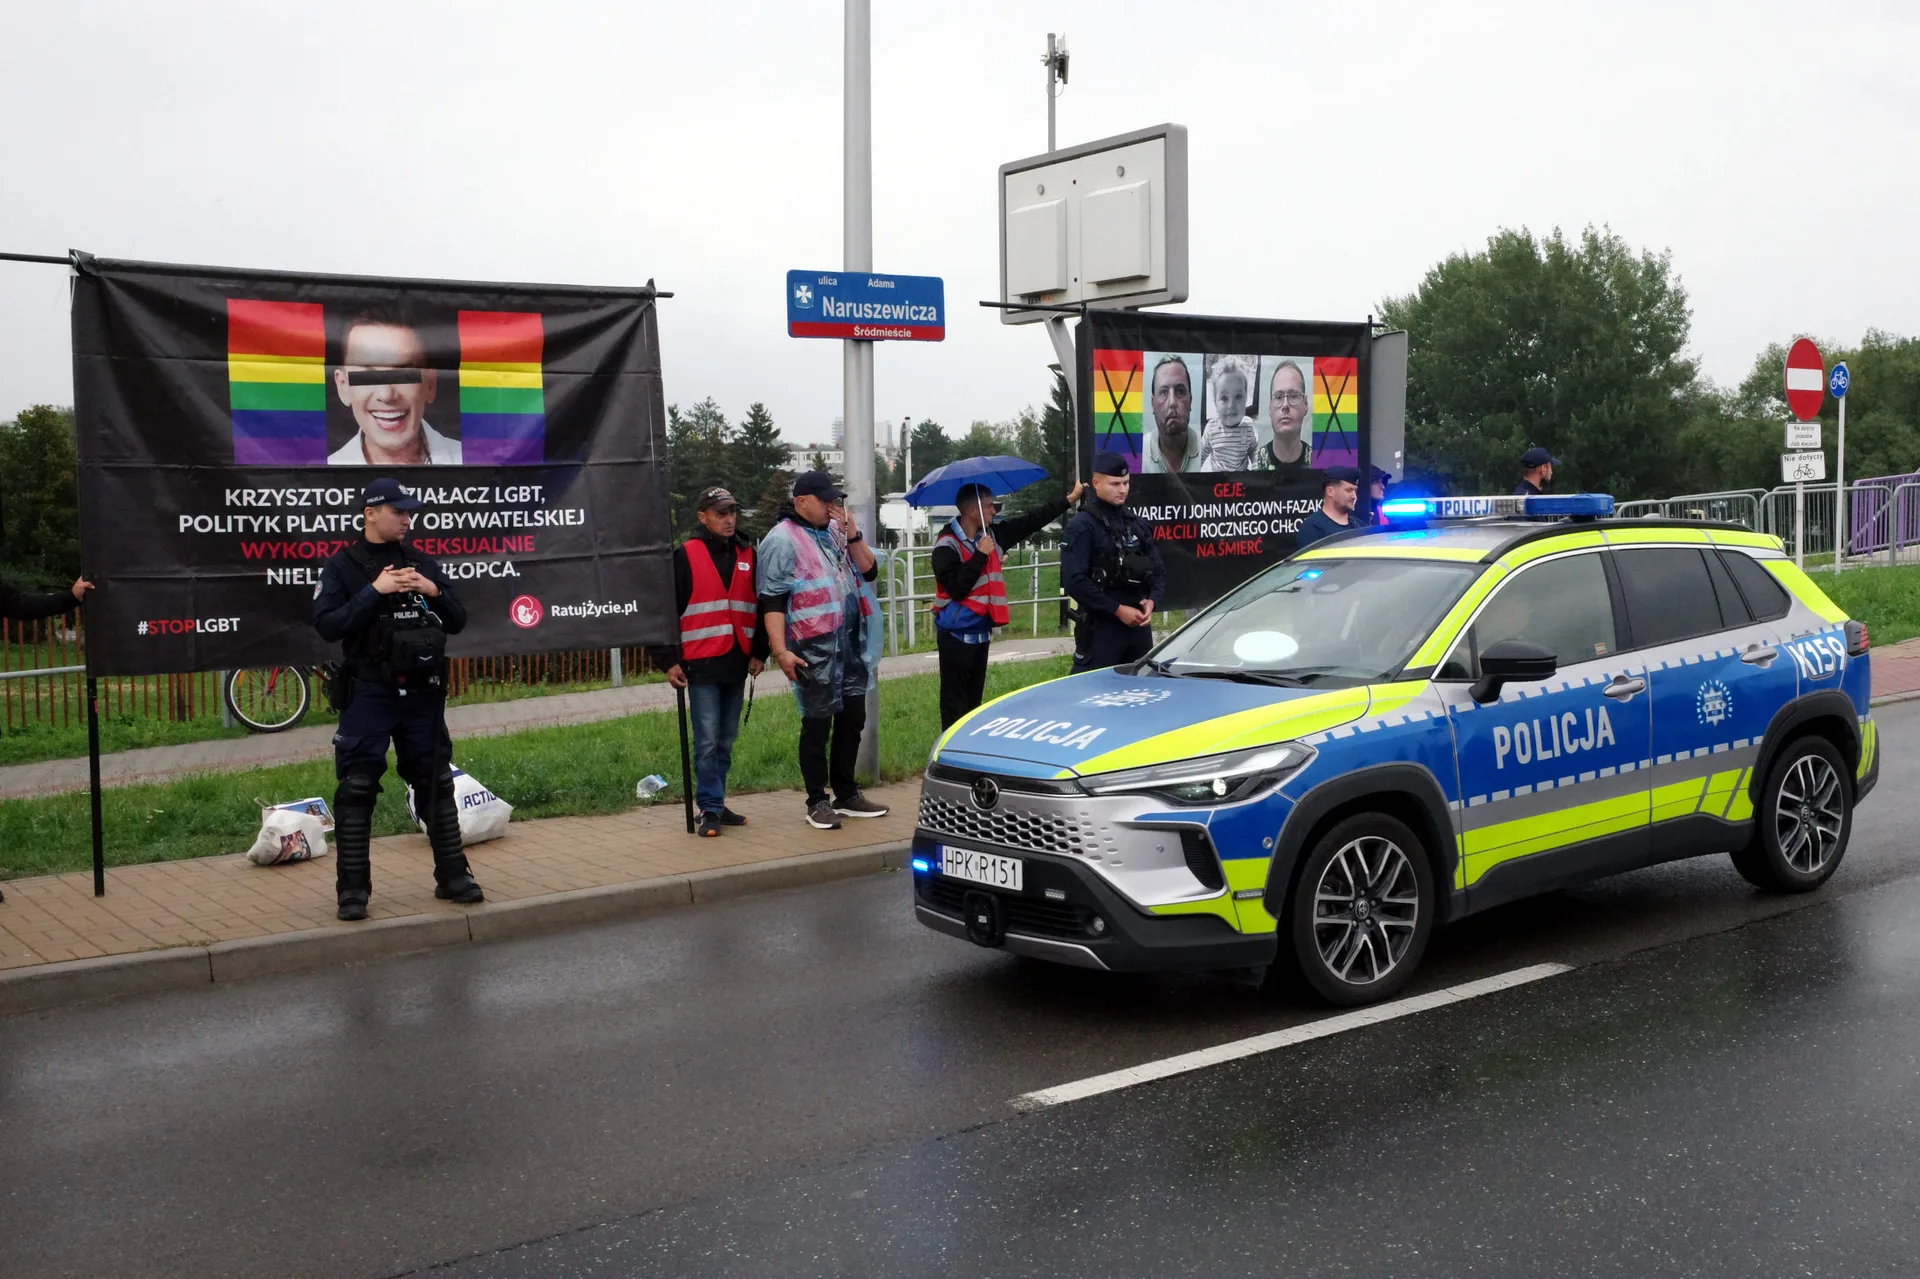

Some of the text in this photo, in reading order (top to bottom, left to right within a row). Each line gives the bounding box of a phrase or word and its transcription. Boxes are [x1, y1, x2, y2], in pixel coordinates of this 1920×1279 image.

[818, 276, 895, 289] ulica Adama
[822, 296, 937, 322] Naruszewicza
[853, 325, 912, 338] Śródmieście
[225, 488, 355, 507] KRZYSZTOF
[495, 485, 546, 505] LGBT,
[1213, 482, 1247, 498] GEJE:
[1183, 504, 1187, 519] I
[1189, 503, 1222, 520] JOHN
[1225, 499, 1324, 518] MCGOWN-FAZAK
[179, 509, 585, 533] POLITYK PLATFOY OBYWATELSKIEJ
[1200, 520, 1268, 538] ROCZNEGO
[1271, 518, 1304, 533] CHŁO
[412, 535, 536, 556] SEKSUALNIE
[1196, 536, 1264, 559] NA ŚMIERĆ
[266, 567, 324, 585] NIEL
[393, 611, 419, 619] POLICJA
[551, 600, 638, 618] RatujŻycie.pl
[137, 617, 241, 635] #STOPLGBT
[1788, 636, 1846, 679] K159
[969, 717, 1107, 750] POLICJA
[1493, 705, 1616, 770] POLICJA
[945, 848, 973, 879] HPK
[979, 855, 1017, 888] R151
